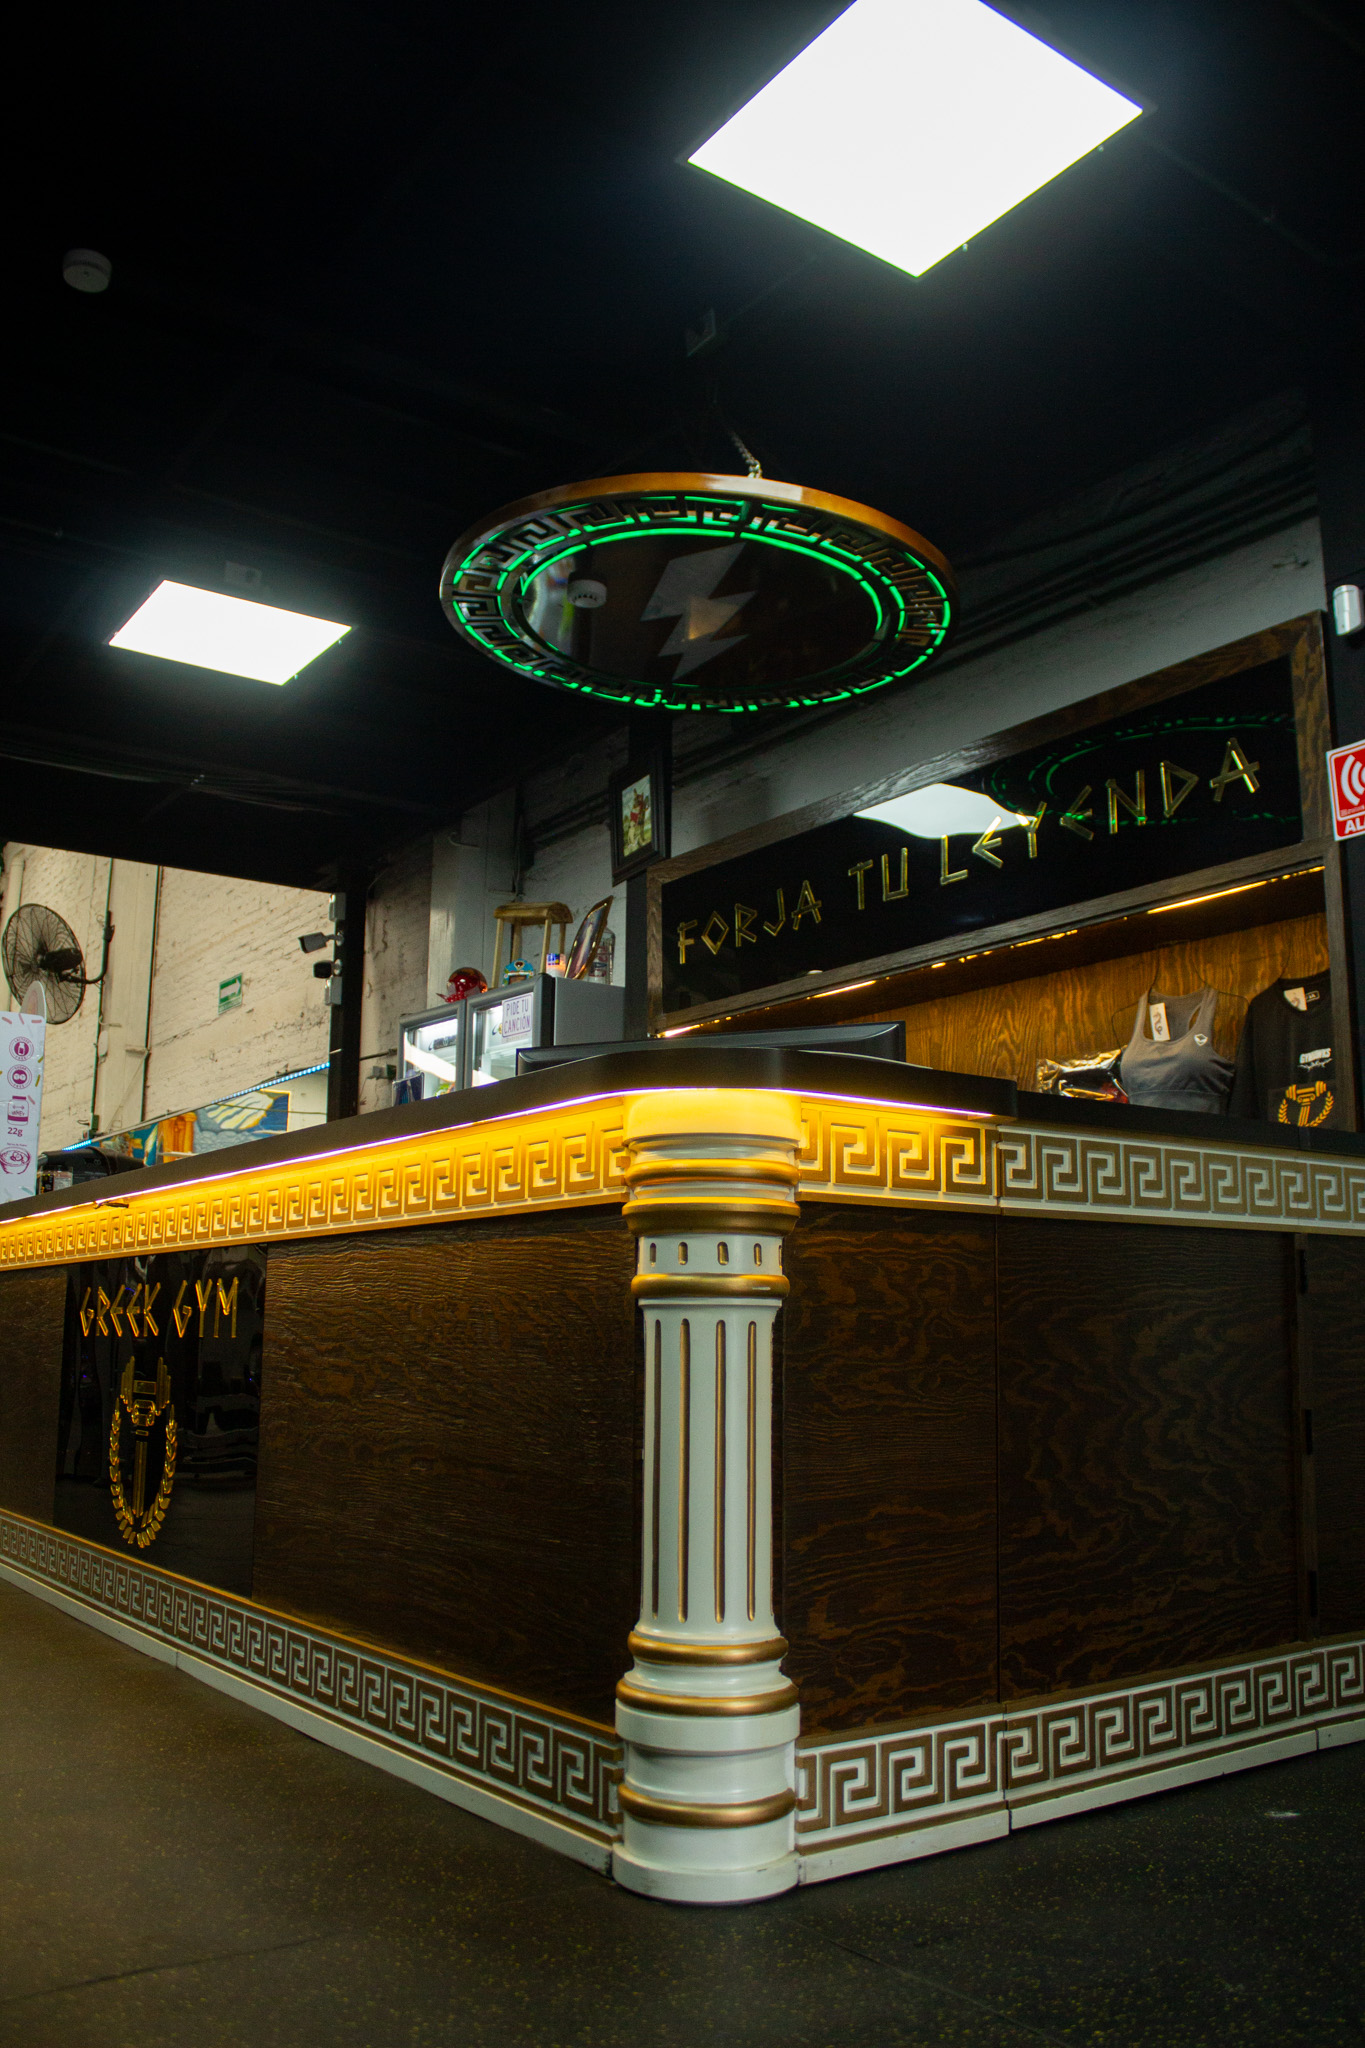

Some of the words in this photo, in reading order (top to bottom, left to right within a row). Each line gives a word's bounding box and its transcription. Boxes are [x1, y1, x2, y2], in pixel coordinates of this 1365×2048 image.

[1344, 817, 1365, 834] AL
[676, 879, 823, 965] FORJA
[847, 846, 910, 911] TU
[938, 737, 1262, 887] LEYENDA
[506, 1000, 520, 1017] PIDE
[521, 998, 529, 1013] TU
[503, 1013, 531, 1035] CANCIÓN
[7, 1126, 23, 1138] 22g
[79, 1281, 161, 1338] GREEK
[172, 1276, 240, 1338] GYM
